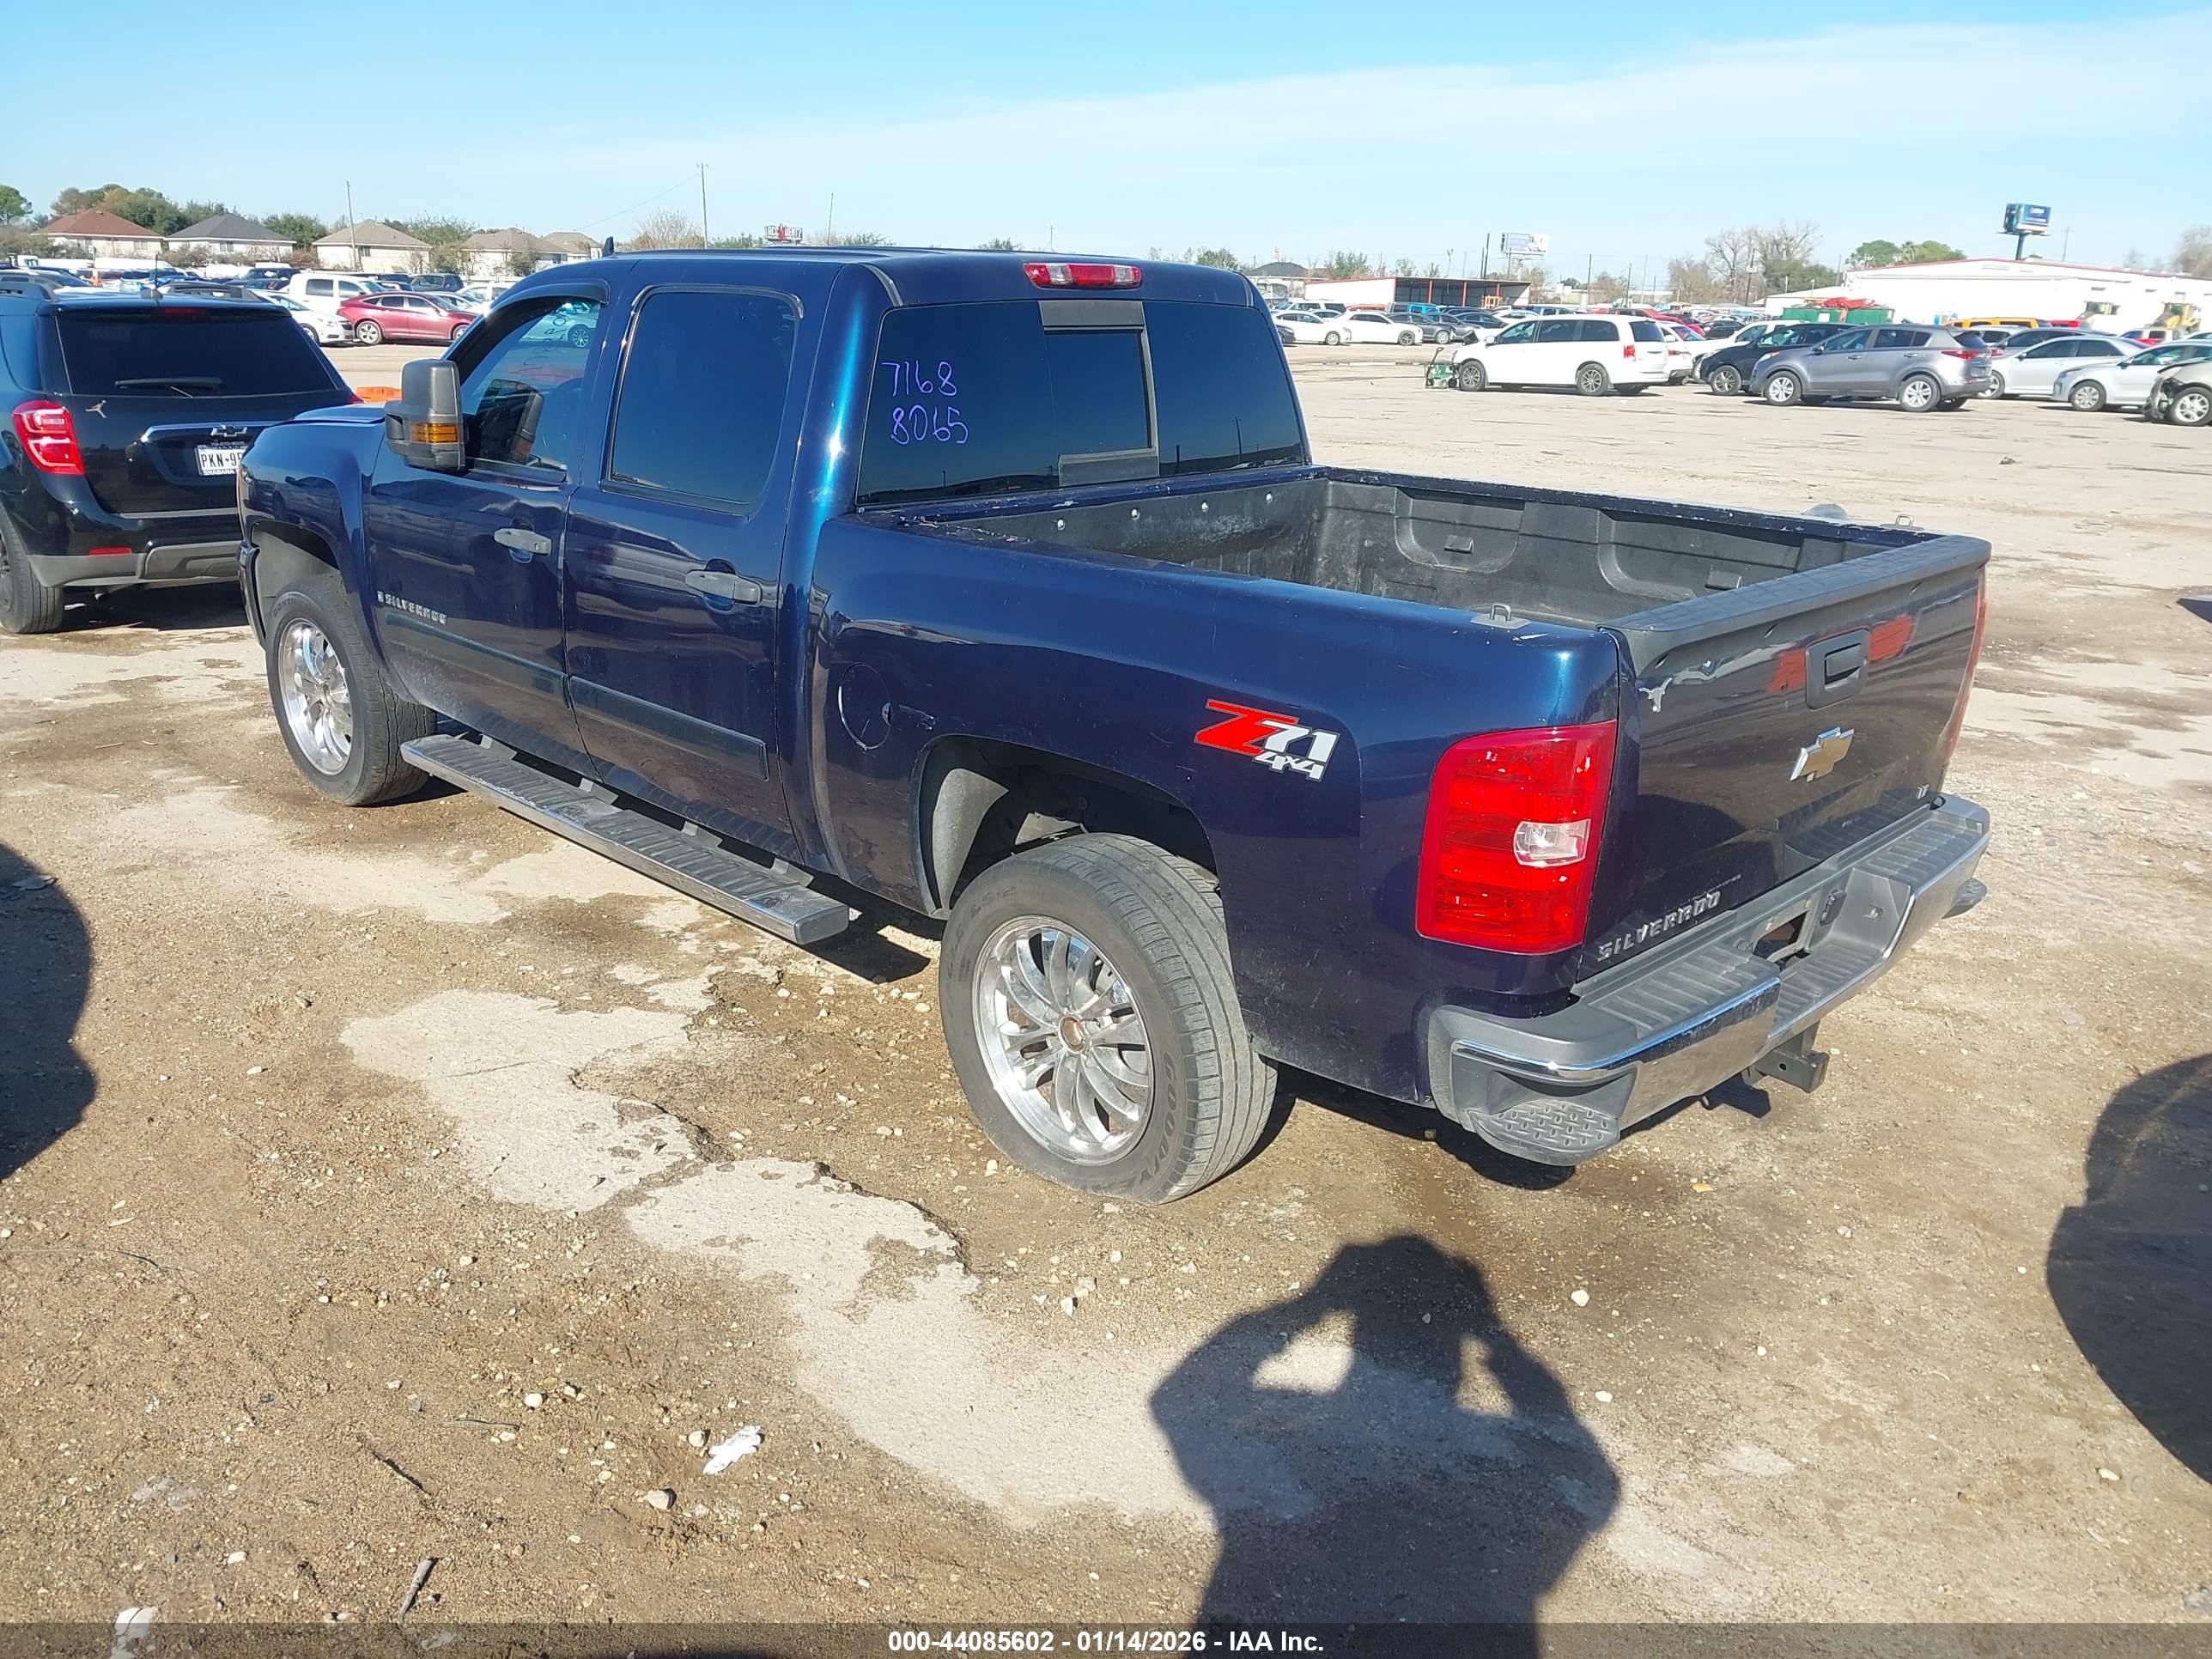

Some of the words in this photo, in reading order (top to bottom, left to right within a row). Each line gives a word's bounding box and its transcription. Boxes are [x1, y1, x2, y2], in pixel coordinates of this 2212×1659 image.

[881, 360, 957, 396] 7168
[891, 405, 969, 444] 8065
[385, 592, 447, 625] SILVERADO
[1194, 698, 1340, 764] Z71
[1597, 890, 1721, 962] SILVERADO
